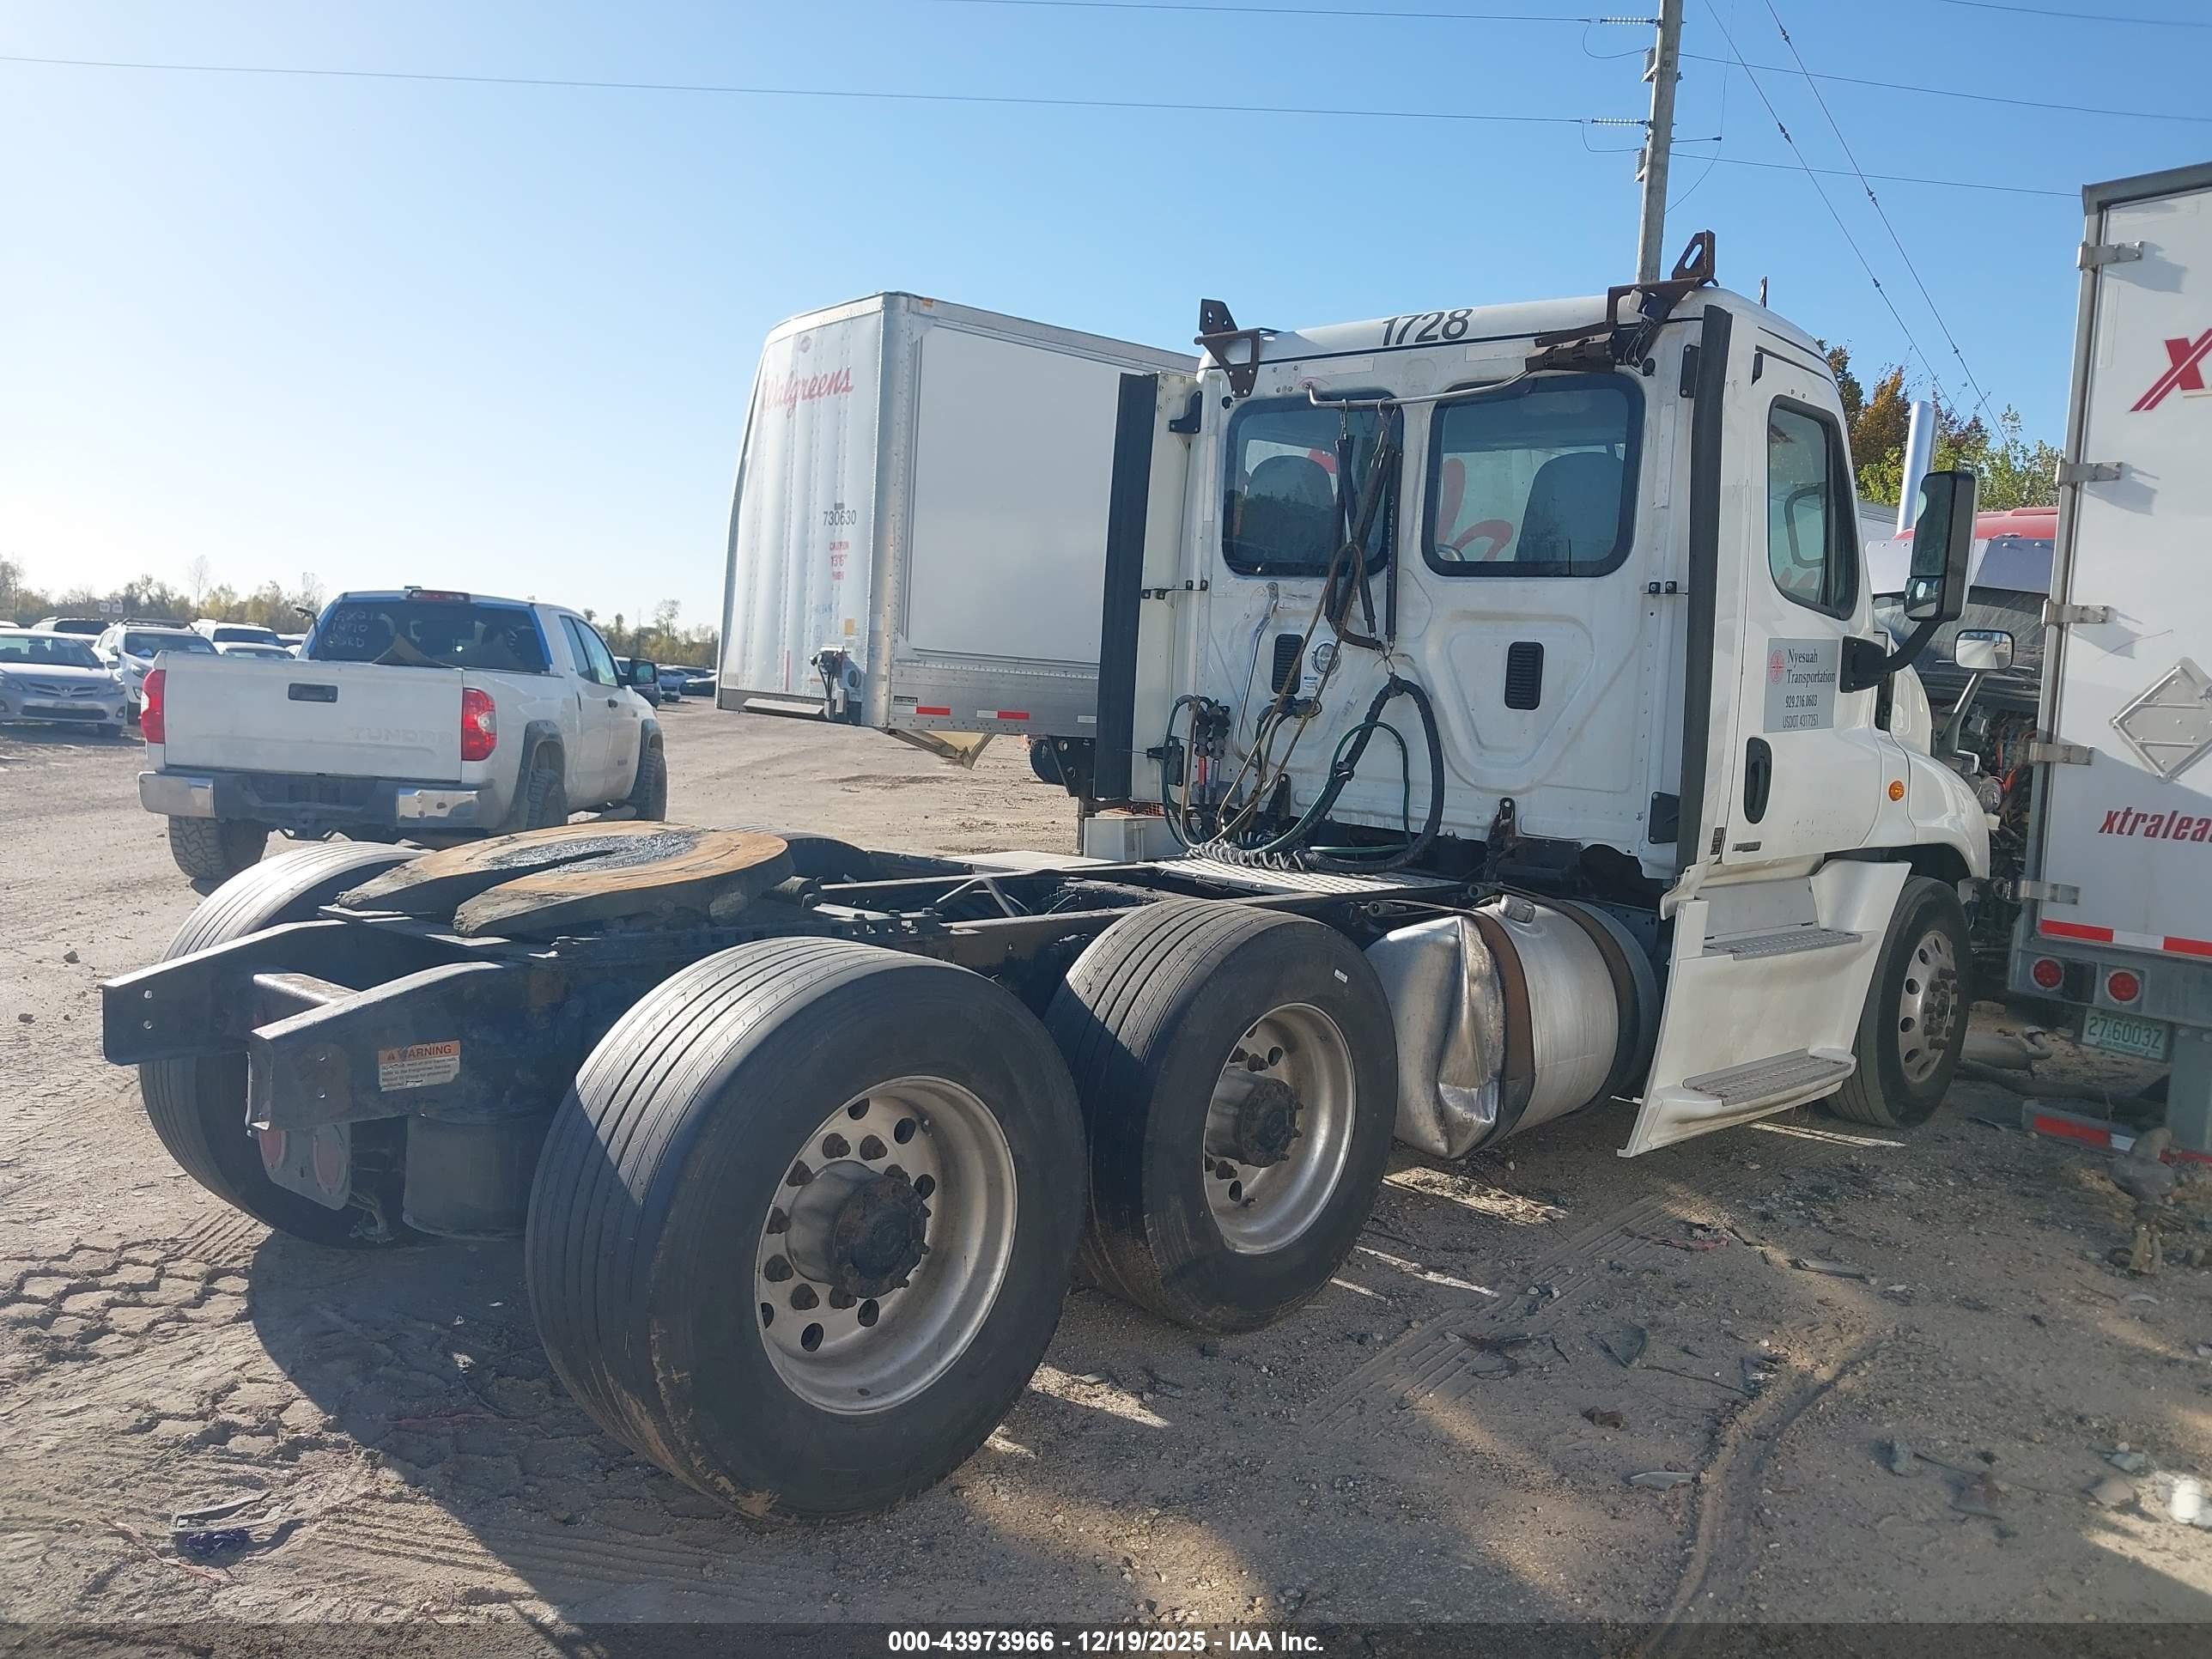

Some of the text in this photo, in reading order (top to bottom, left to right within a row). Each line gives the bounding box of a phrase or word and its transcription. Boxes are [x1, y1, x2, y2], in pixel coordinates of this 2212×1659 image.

[1382, 308, 1474, 347] 1728
[762, 365, 854, 419] Walgreens
[823, 509, 857, 526] 730630
[1787, 648, 1818, 668] Nyesuah
[1786, 668, 1836, 688] Transportation
[1782, 714, 1799, 728] USDOT
[349, 726, 453, 744] TUNDRA
[2098, 806, 2212, 842] xtralea
